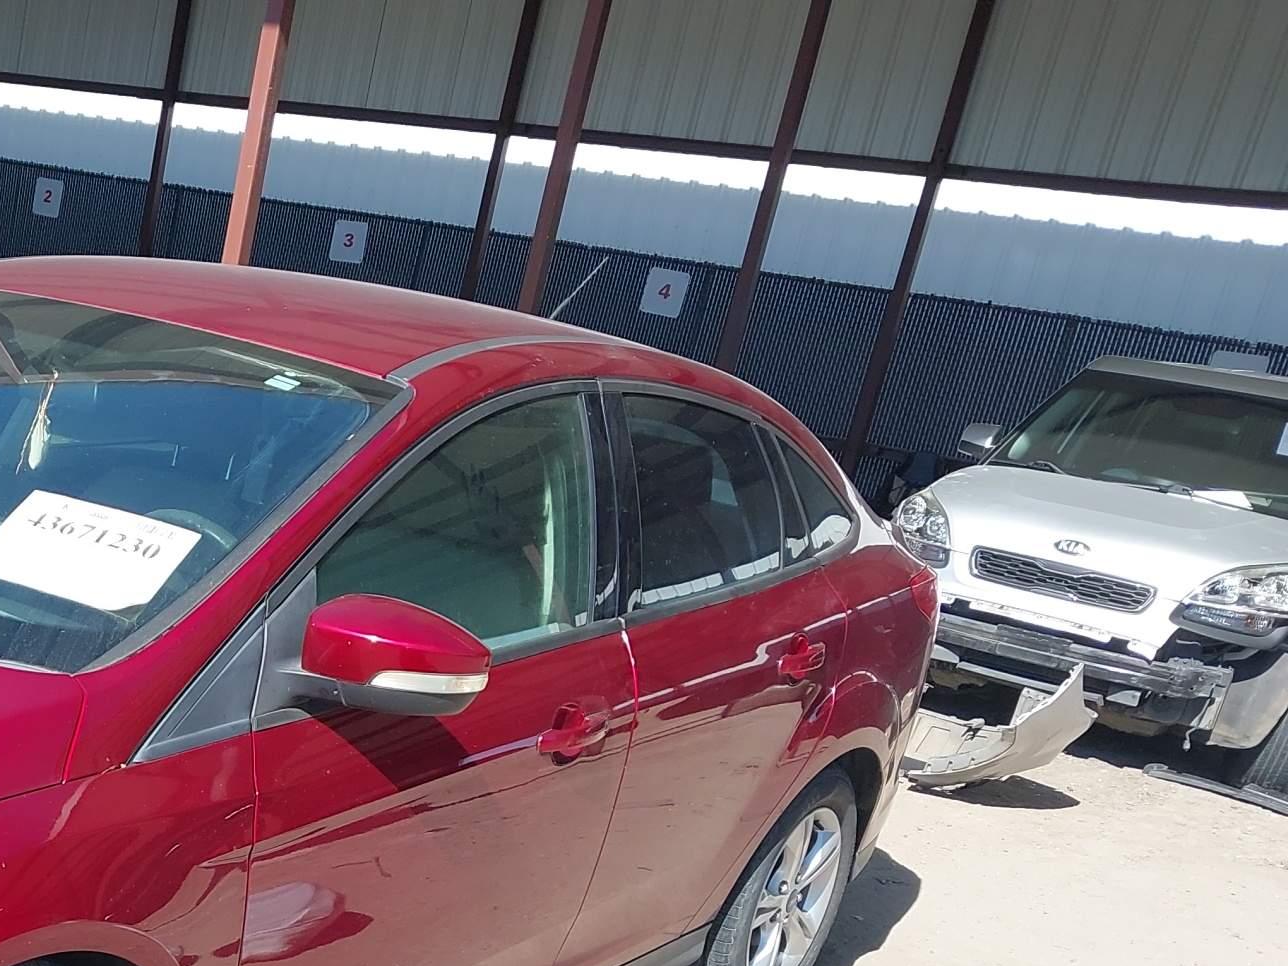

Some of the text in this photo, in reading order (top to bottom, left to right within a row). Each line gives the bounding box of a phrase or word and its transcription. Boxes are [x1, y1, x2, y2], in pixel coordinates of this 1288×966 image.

[43, 190, 52, 203] 2
[343, 233, 354, 248] 3
[658, 283, 671, 299] 4
[27, 512, 162, 560] 43671230
[1055, 540, 1086, 555] KIA
